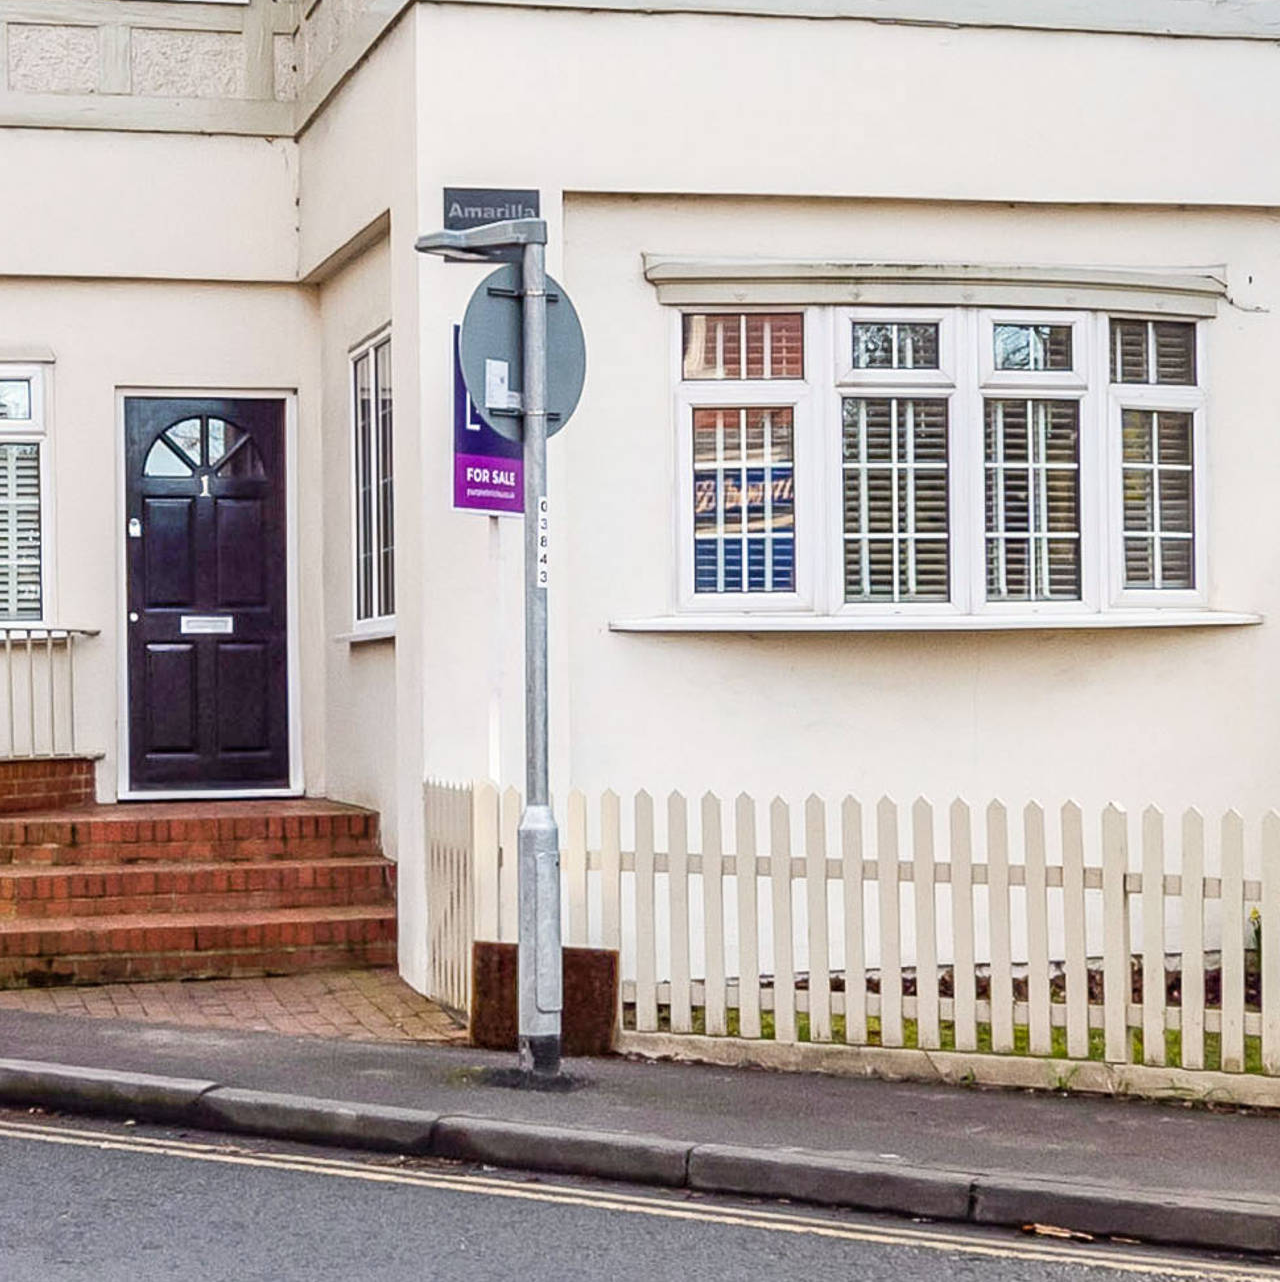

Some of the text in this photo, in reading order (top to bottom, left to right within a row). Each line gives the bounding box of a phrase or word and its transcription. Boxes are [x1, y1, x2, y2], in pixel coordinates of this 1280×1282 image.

[448, 202, 536, 218] Amarilla
[200, 475, 211, 496] 1
[466, 467, 515, 486] FOR SALE
